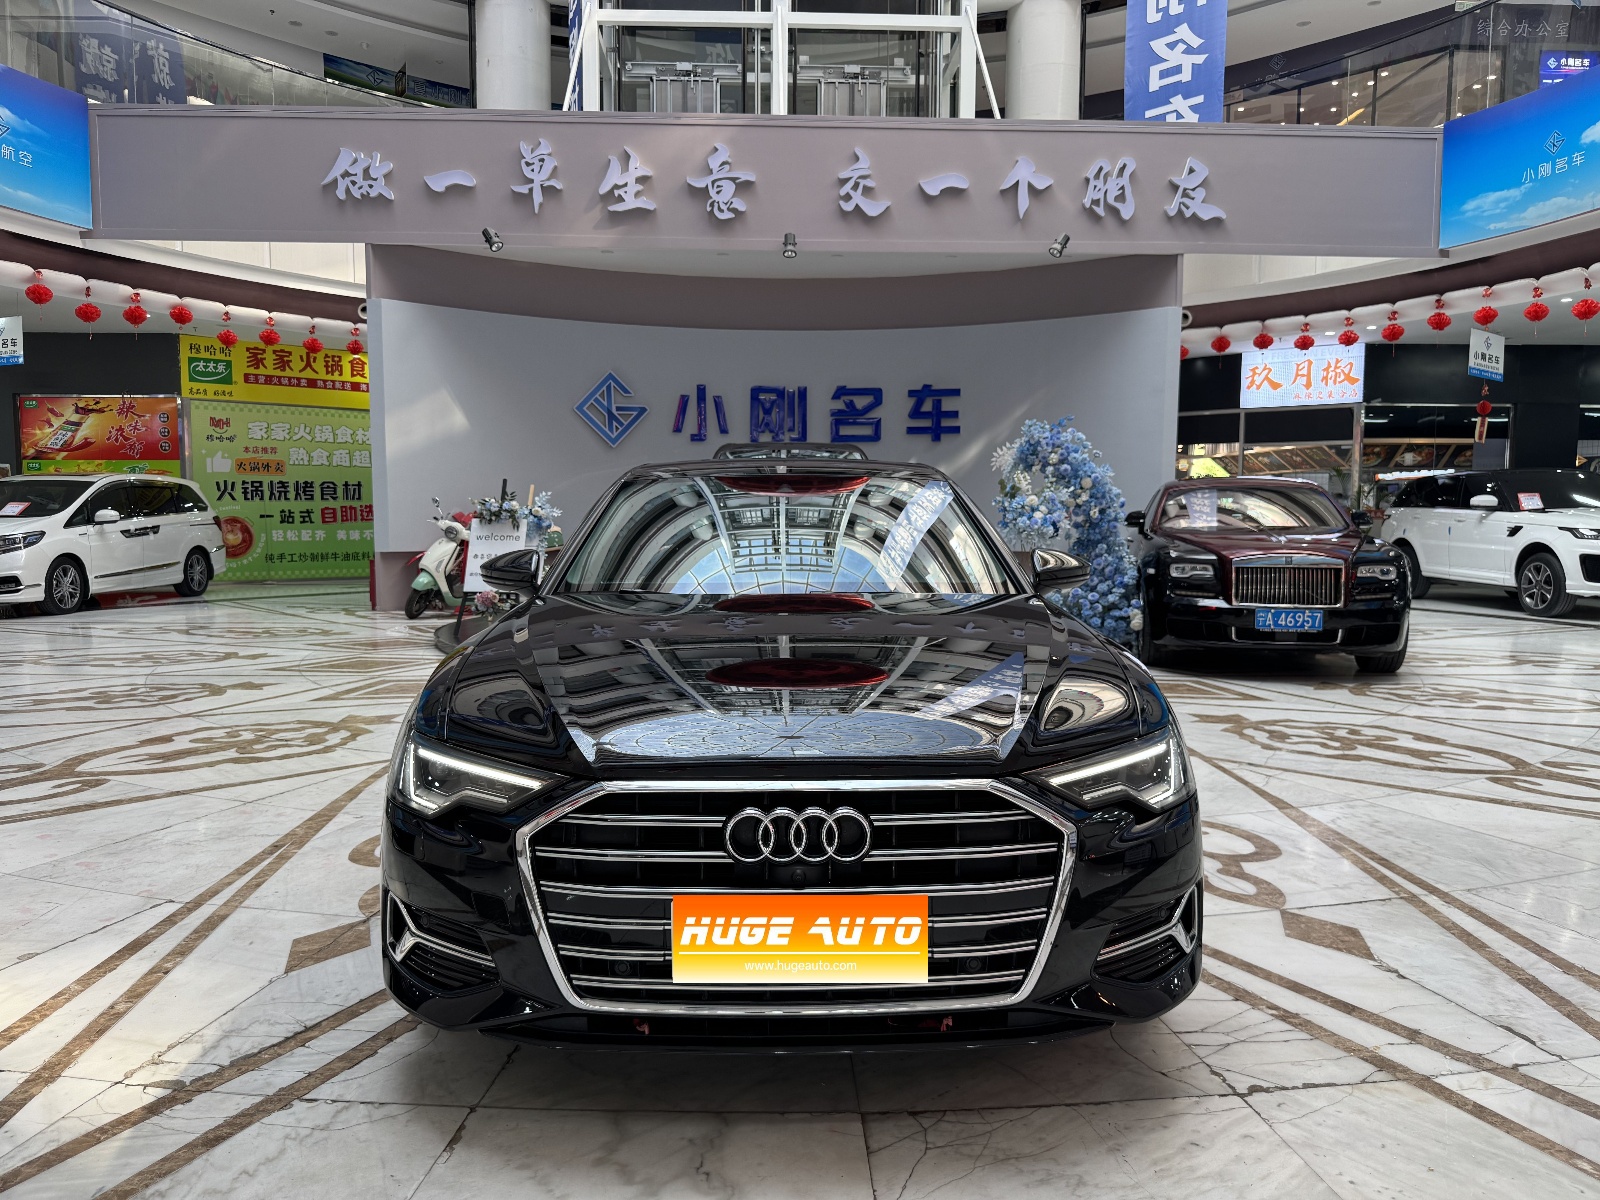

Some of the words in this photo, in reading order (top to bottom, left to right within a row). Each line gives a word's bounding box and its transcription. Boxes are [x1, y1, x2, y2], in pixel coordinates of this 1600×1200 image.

[1477, 19, 1570, 38] 综合办公室
[1, 144, 33, 168] 航空
[1521, 151, 1586, 184] 小刚名车
[321, 138, 757, 220] 做一单生意
[838, 147, 1227, 221] 交一个朋友
[189, 342, 232, 358] 穆哈哈
[1473, 350, 1500, 365] 小刚名车
[195, 360, 227, 373] 太太乐
[245, 346, 368, 379] 家家火锅食
[1245, 357, 1361, 391] 玖月椒
[672, 383, 961, 443] 小刚名车
[206, 434, 235, 443] 穆哈哈
[247, 421, 372, 445] 家家火锅食材
[243, 446, 278, 455] 本店推荐
[288, 447, 372, 468] 熟食商超
[236, 461, 284, 473] 火锅外卖
[215, 479, 363, 502] 火锅烧烤食材
[271, 529, 326, 541] 轻松配齐
[476, 533, 520, 542] welcome
